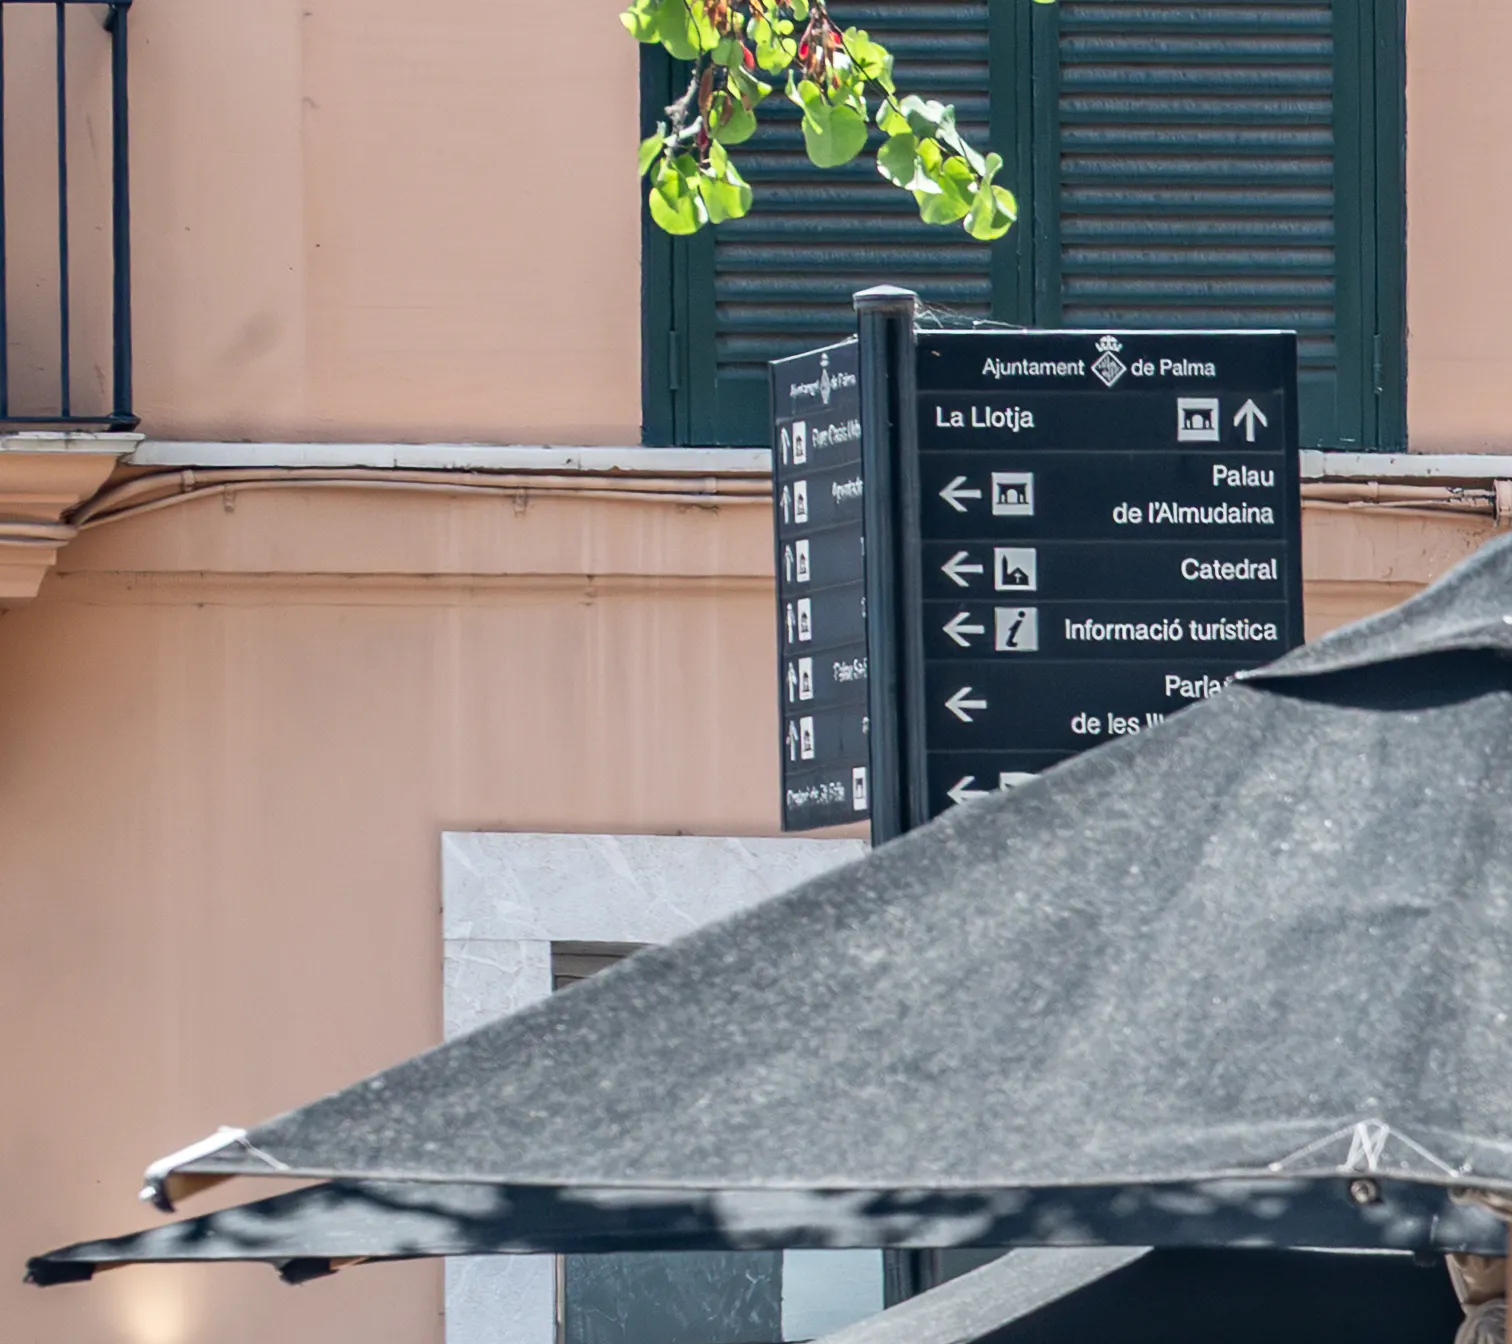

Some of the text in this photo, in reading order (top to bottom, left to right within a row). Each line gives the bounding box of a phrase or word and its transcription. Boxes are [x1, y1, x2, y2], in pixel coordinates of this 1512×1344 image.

[982, 358, 1216, 378] Ajuntament de Palma
[936, 407, 1035, 432] La Llotja
[1212, 464, 1275, 487] Palau
[1113, 501, 1274, 524] de l'Almudaina
[1180, 558, 1278, 581] Catedral
[1065, 617, 1278, 641] Informació turística
[1164, 675, 1232, 698] Parla
[1071, 714, 1101, 735] de
[1107, 713, 1140, 735] les
